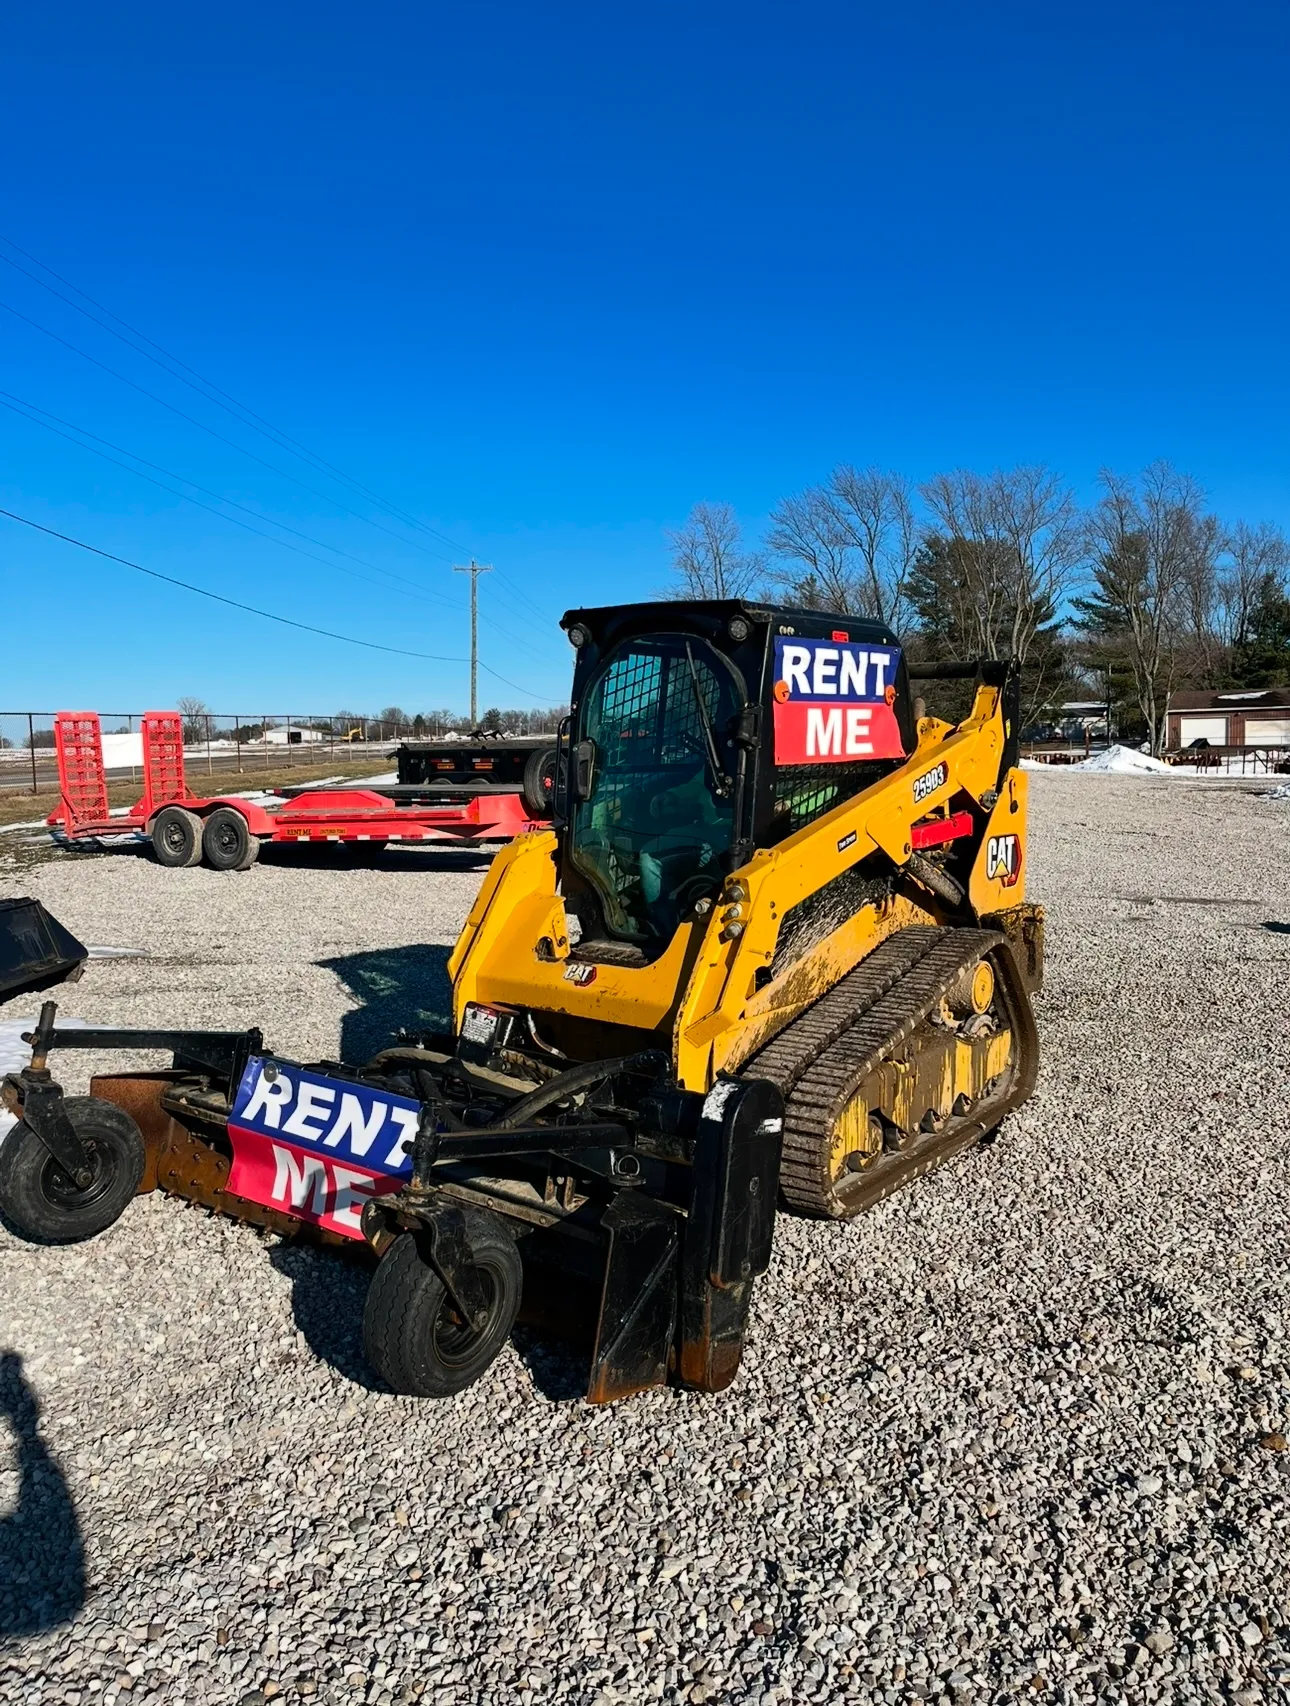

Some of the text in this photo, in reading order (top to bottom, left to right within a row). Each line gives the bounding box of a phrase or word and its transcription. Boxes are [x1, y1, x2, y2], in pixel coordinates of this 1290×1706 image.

[782, 645, 890, 696] RENT
[806, 708, 874, 757] ME
[913, 764, 944, 802] 259D3
[987, 835, 1015, 879] CAT
[564, 963, 594, 982] CAT
[240, 1067, 420, 1169] RENT
[271, 1143, 376, 1231] ME
